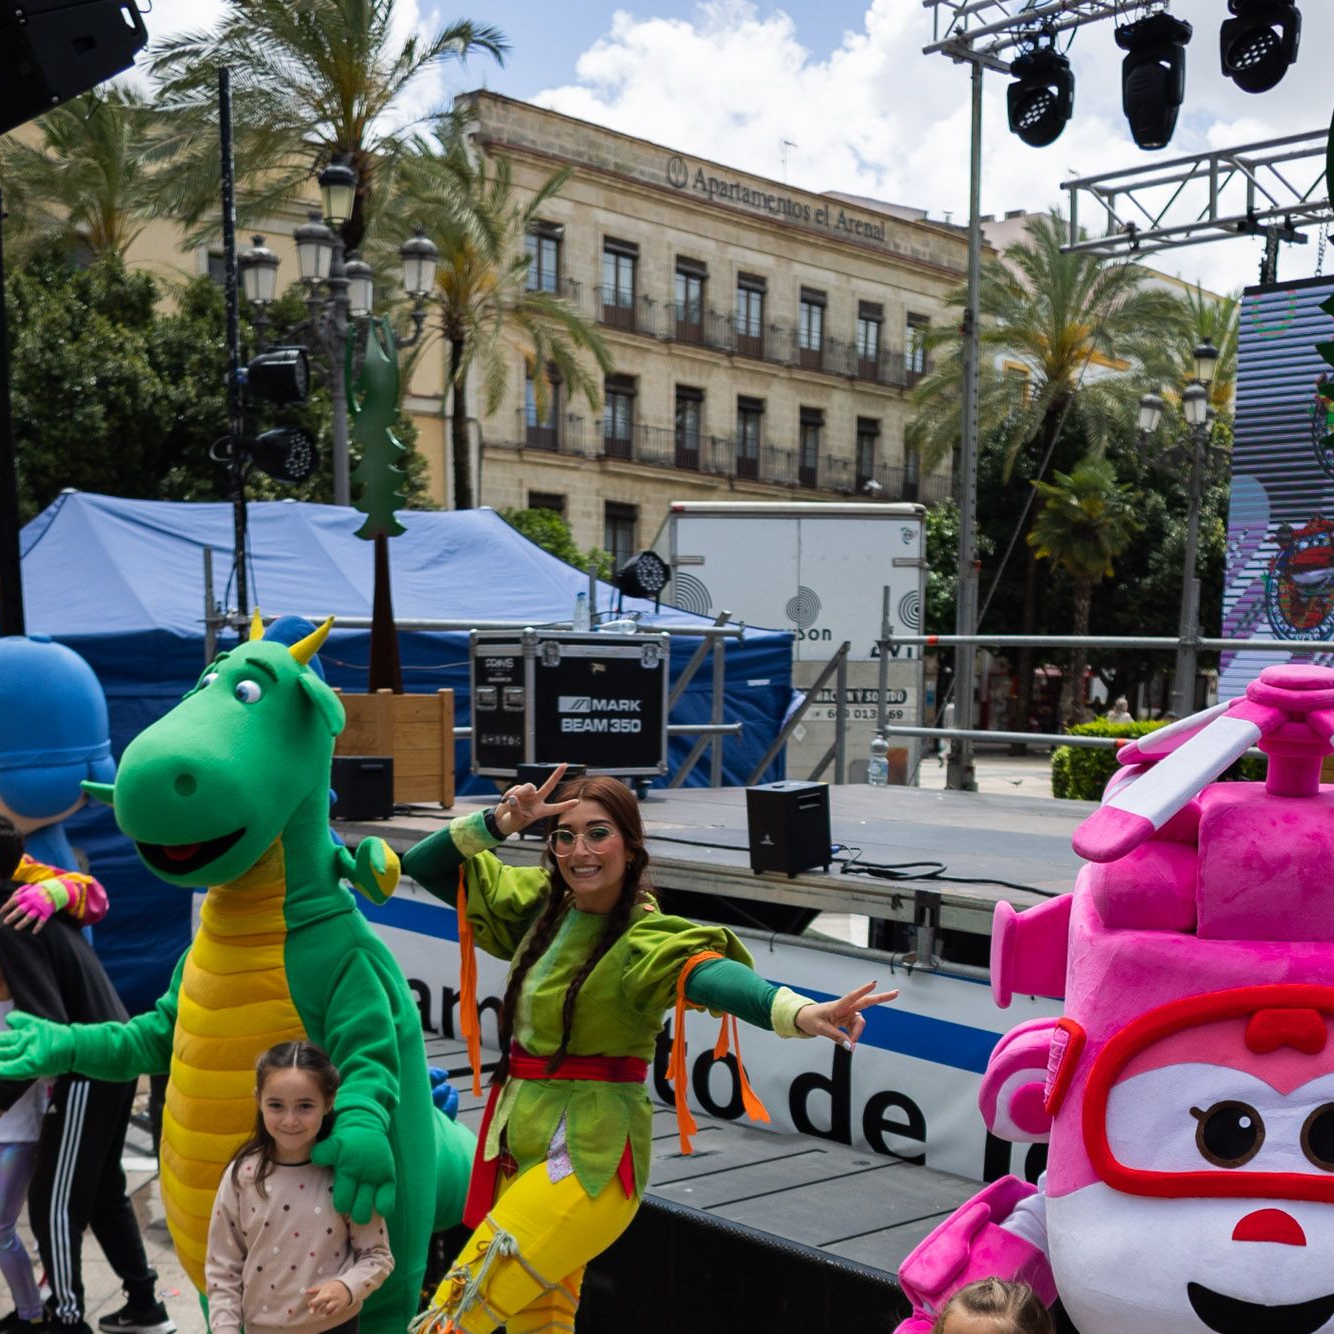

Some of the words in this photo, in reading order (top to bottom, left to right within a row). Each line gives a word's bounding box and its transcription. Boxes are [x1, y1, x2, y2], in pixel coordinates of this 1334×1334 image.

[692, 166, 811, 221] Apartamentos
[815, 204, 830, 226] el
[835, 209, 886, 241] Arenal
[561, 718, 608, 732] BEAM
[610, 719, 642, 732] 350
[592, 699, 641, 712] MARK
[789, 1043, 927, 1166] de
